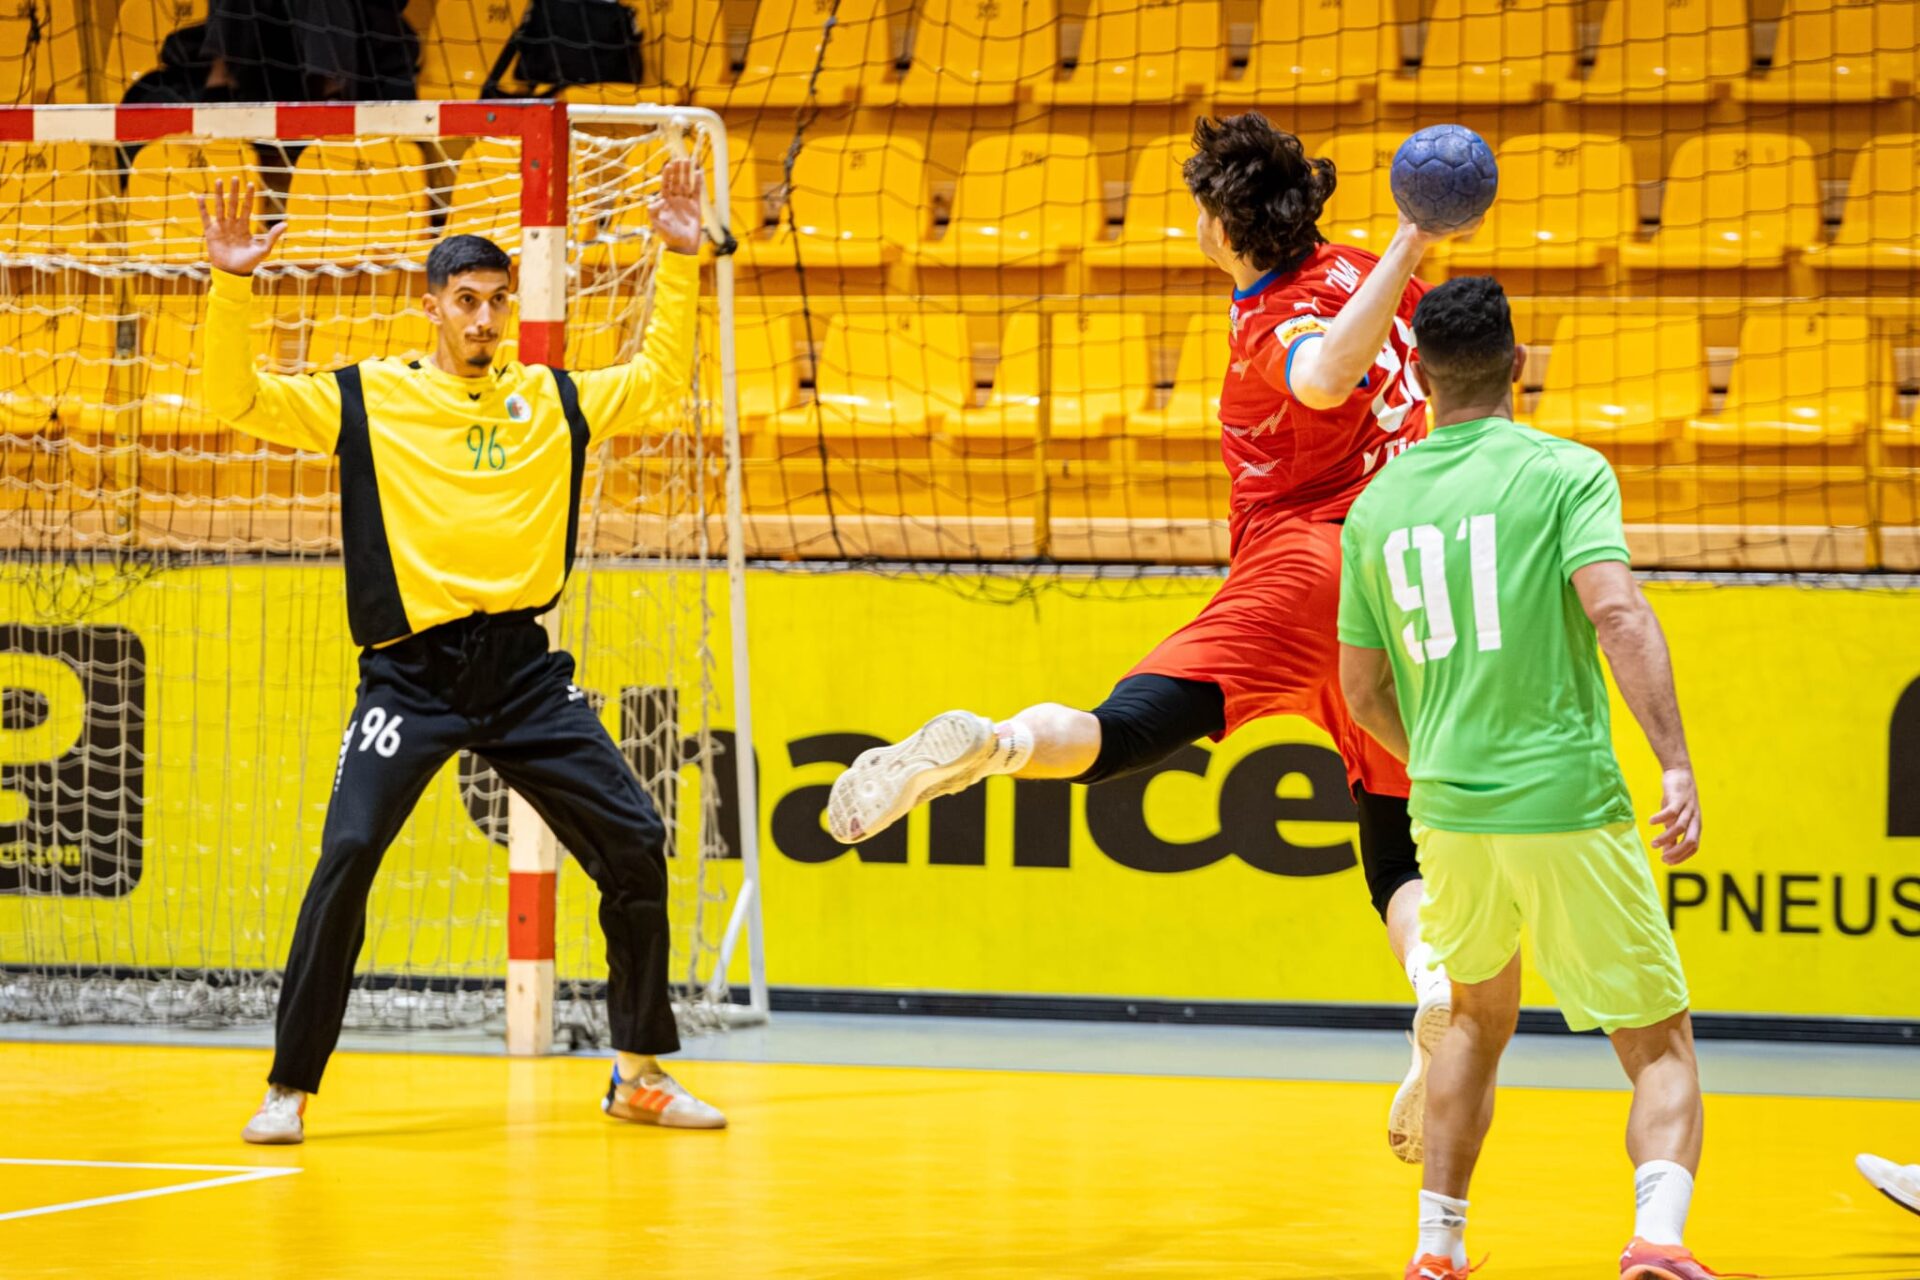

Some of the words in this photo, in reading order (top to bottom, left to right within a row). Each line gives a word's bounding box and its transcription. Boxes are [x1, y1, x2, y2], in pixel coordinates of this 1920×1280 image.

[466, 424, 506, 471] 96
[1382, 513, 1502, 665] 91
[358, 706, 404, 758] 96
